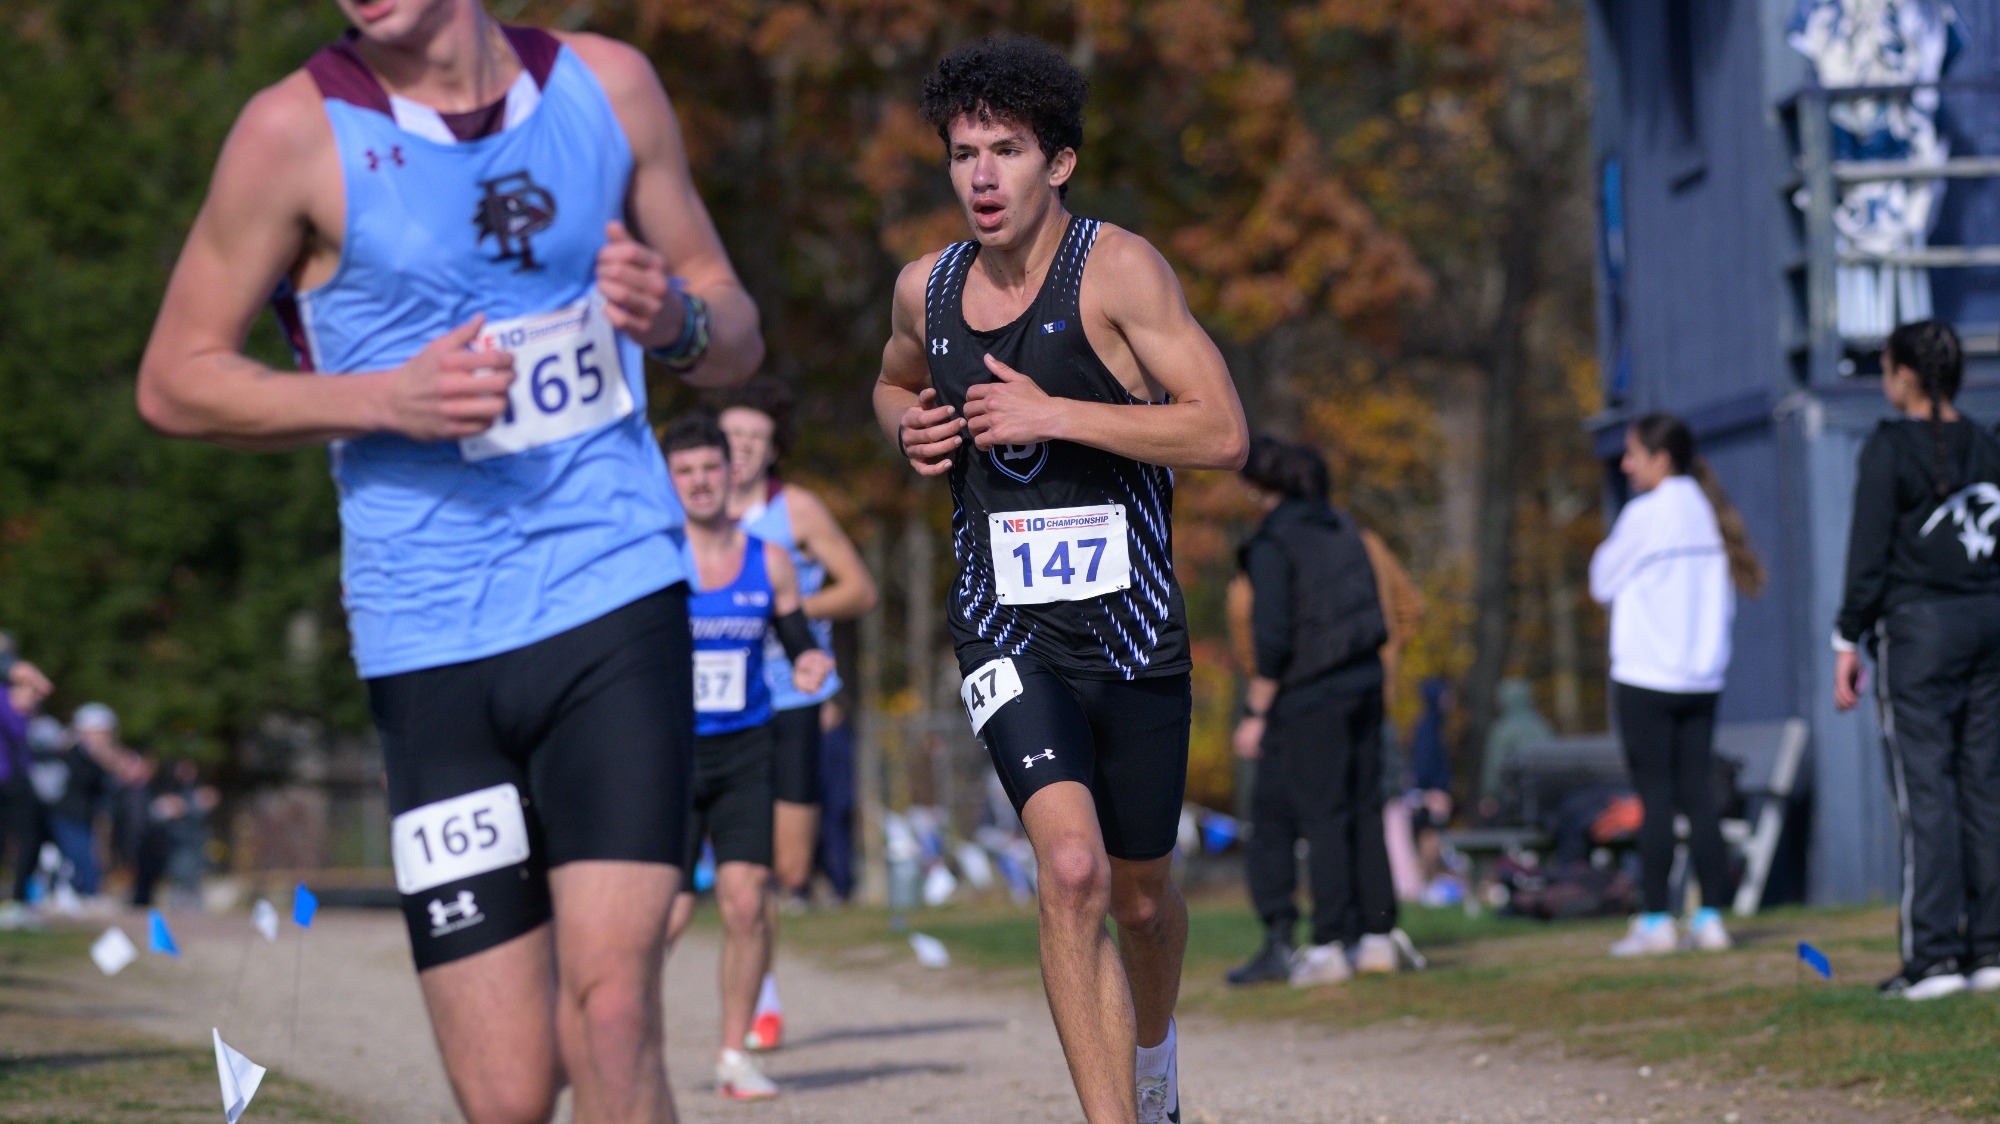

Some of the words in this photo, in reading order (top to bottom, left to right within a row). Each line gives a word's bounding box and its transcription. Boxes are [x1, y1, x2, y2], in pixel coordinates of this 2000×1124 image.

[1041, 320, 1066, 336] NE10
[1003, 518, 1046, 533] NE10
[1046, 515, 1109, 528] CHAMPIONSHIP
[1012, 537, 1108, 588] 147
[413, 807, 499, 865] 165
